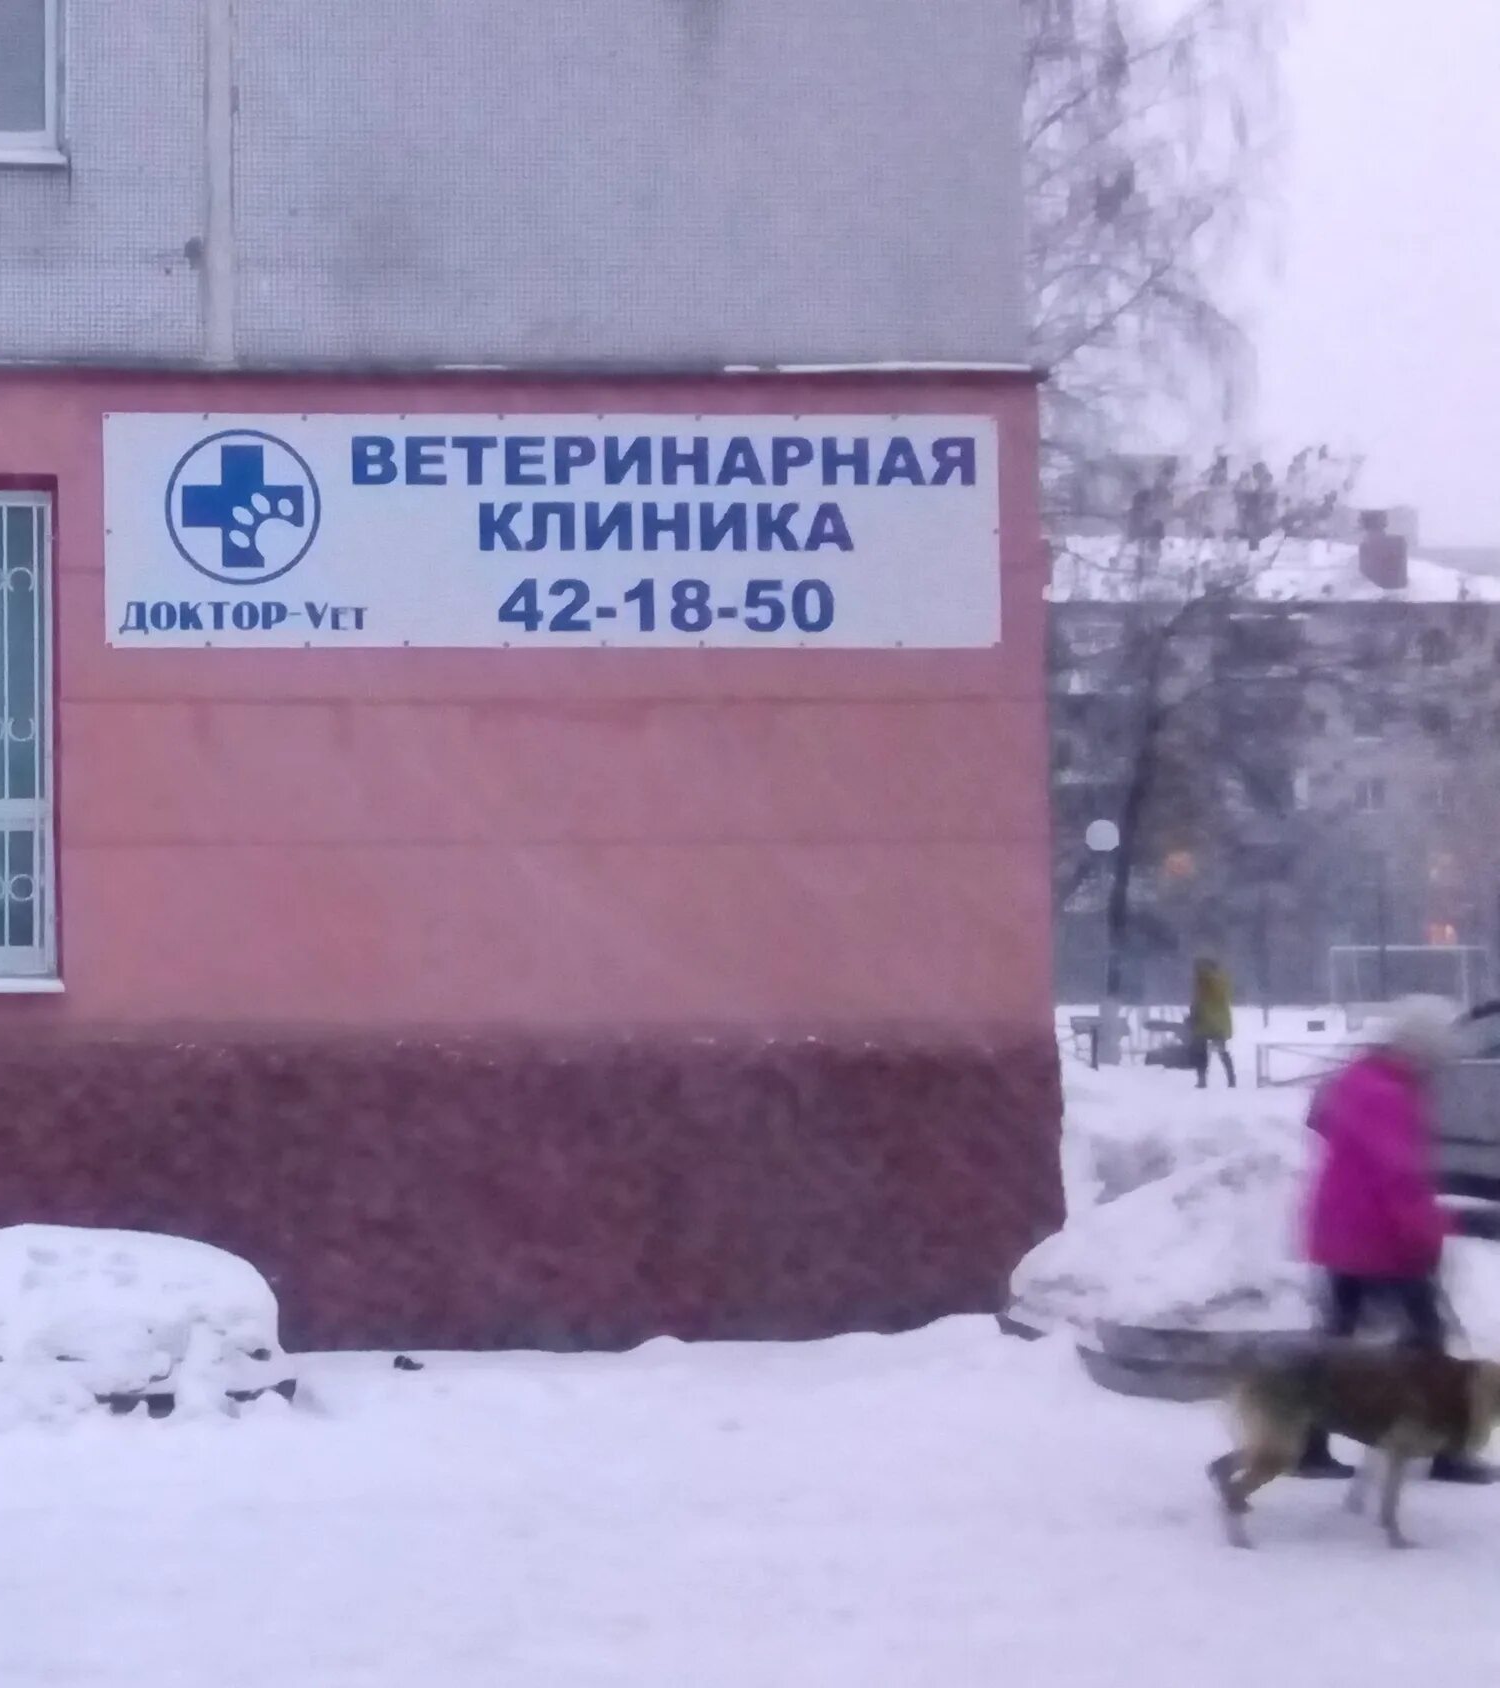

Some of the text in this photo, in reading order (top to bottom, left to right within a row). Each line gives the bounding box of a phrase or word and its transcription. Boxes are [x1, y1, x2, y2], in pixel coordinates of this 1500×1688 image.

[350, 435, 977, 487] ВЕТЕРИНАРНАЯ
[477, 501, 854, 552] КЛИНИКА
[498, 578, 836, 632] 42-18-50
